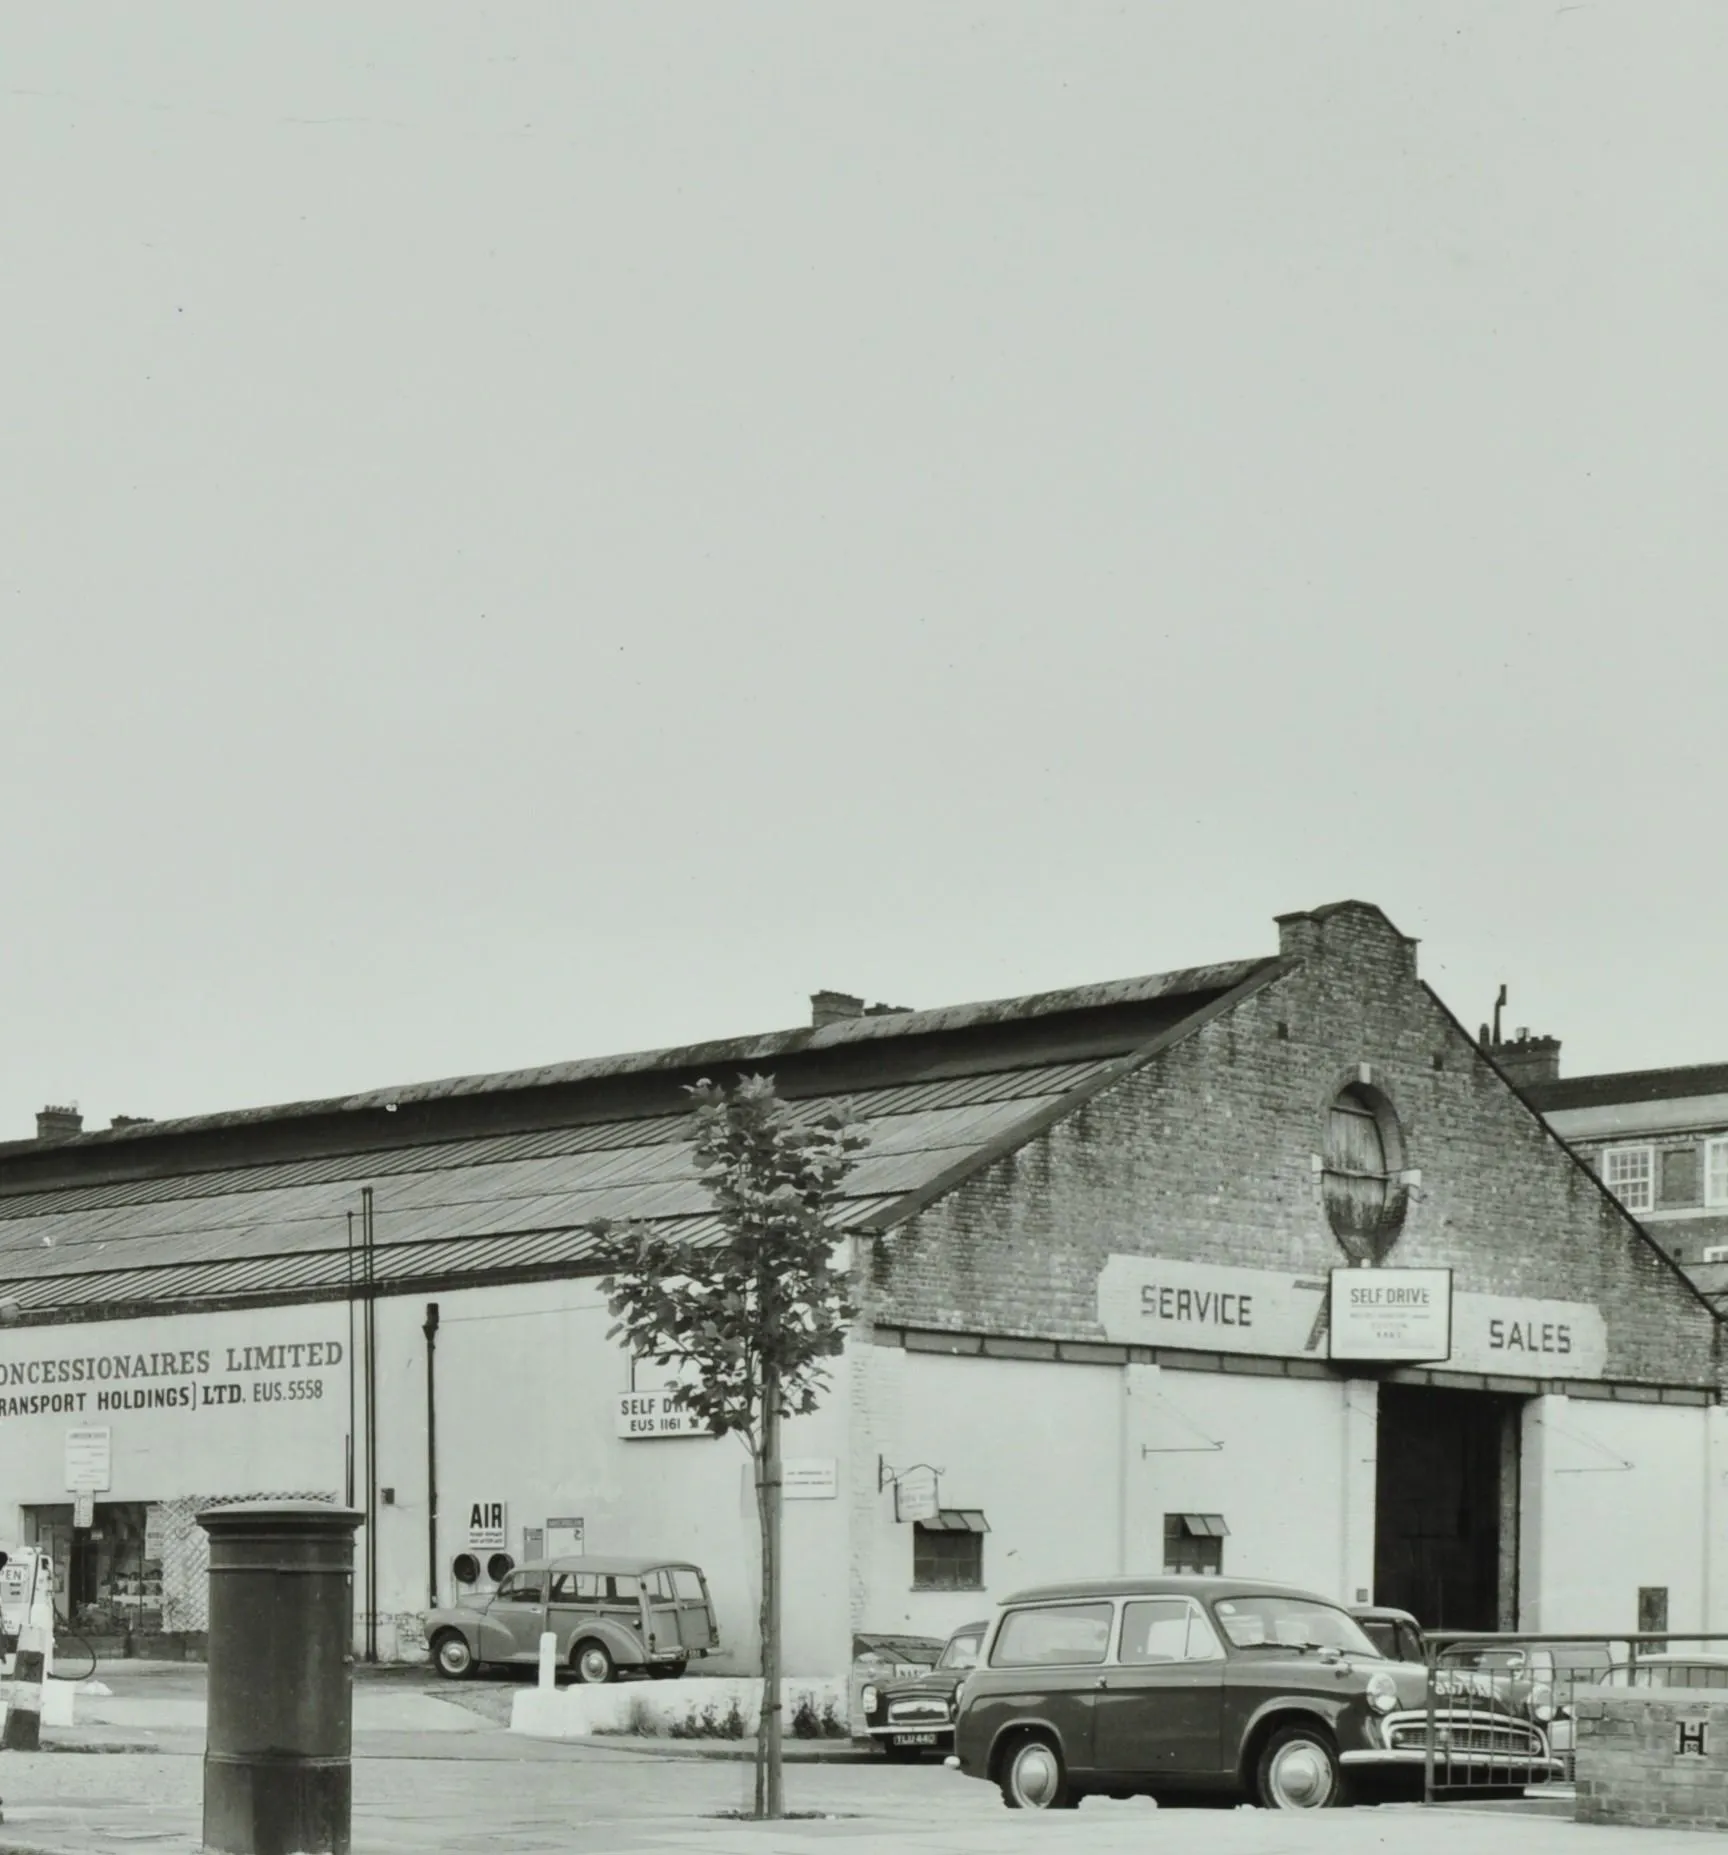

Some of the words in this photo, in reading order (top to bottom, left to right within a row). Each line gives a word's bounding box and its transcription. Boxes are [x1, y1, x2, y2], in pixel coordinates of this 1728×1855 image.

[1141, 1285, 1252, 1326] SERVICE
[1350, 1287, 1383, 1304] SELF
[1387, 1287, 1430, 1304] DRIVE
[1489, 1319, 1571, 1354] SALES
[226, 1341, 343, 1373] LIMITED
[202, 1384, 246, 1405] LTD.
[621, 1399, 656, 1416] SELF
[630, 1418, 654, 1432] EUS
[660, 1418, 681, 1431] 1161
[470, 1503, 502, 1529] AIR
